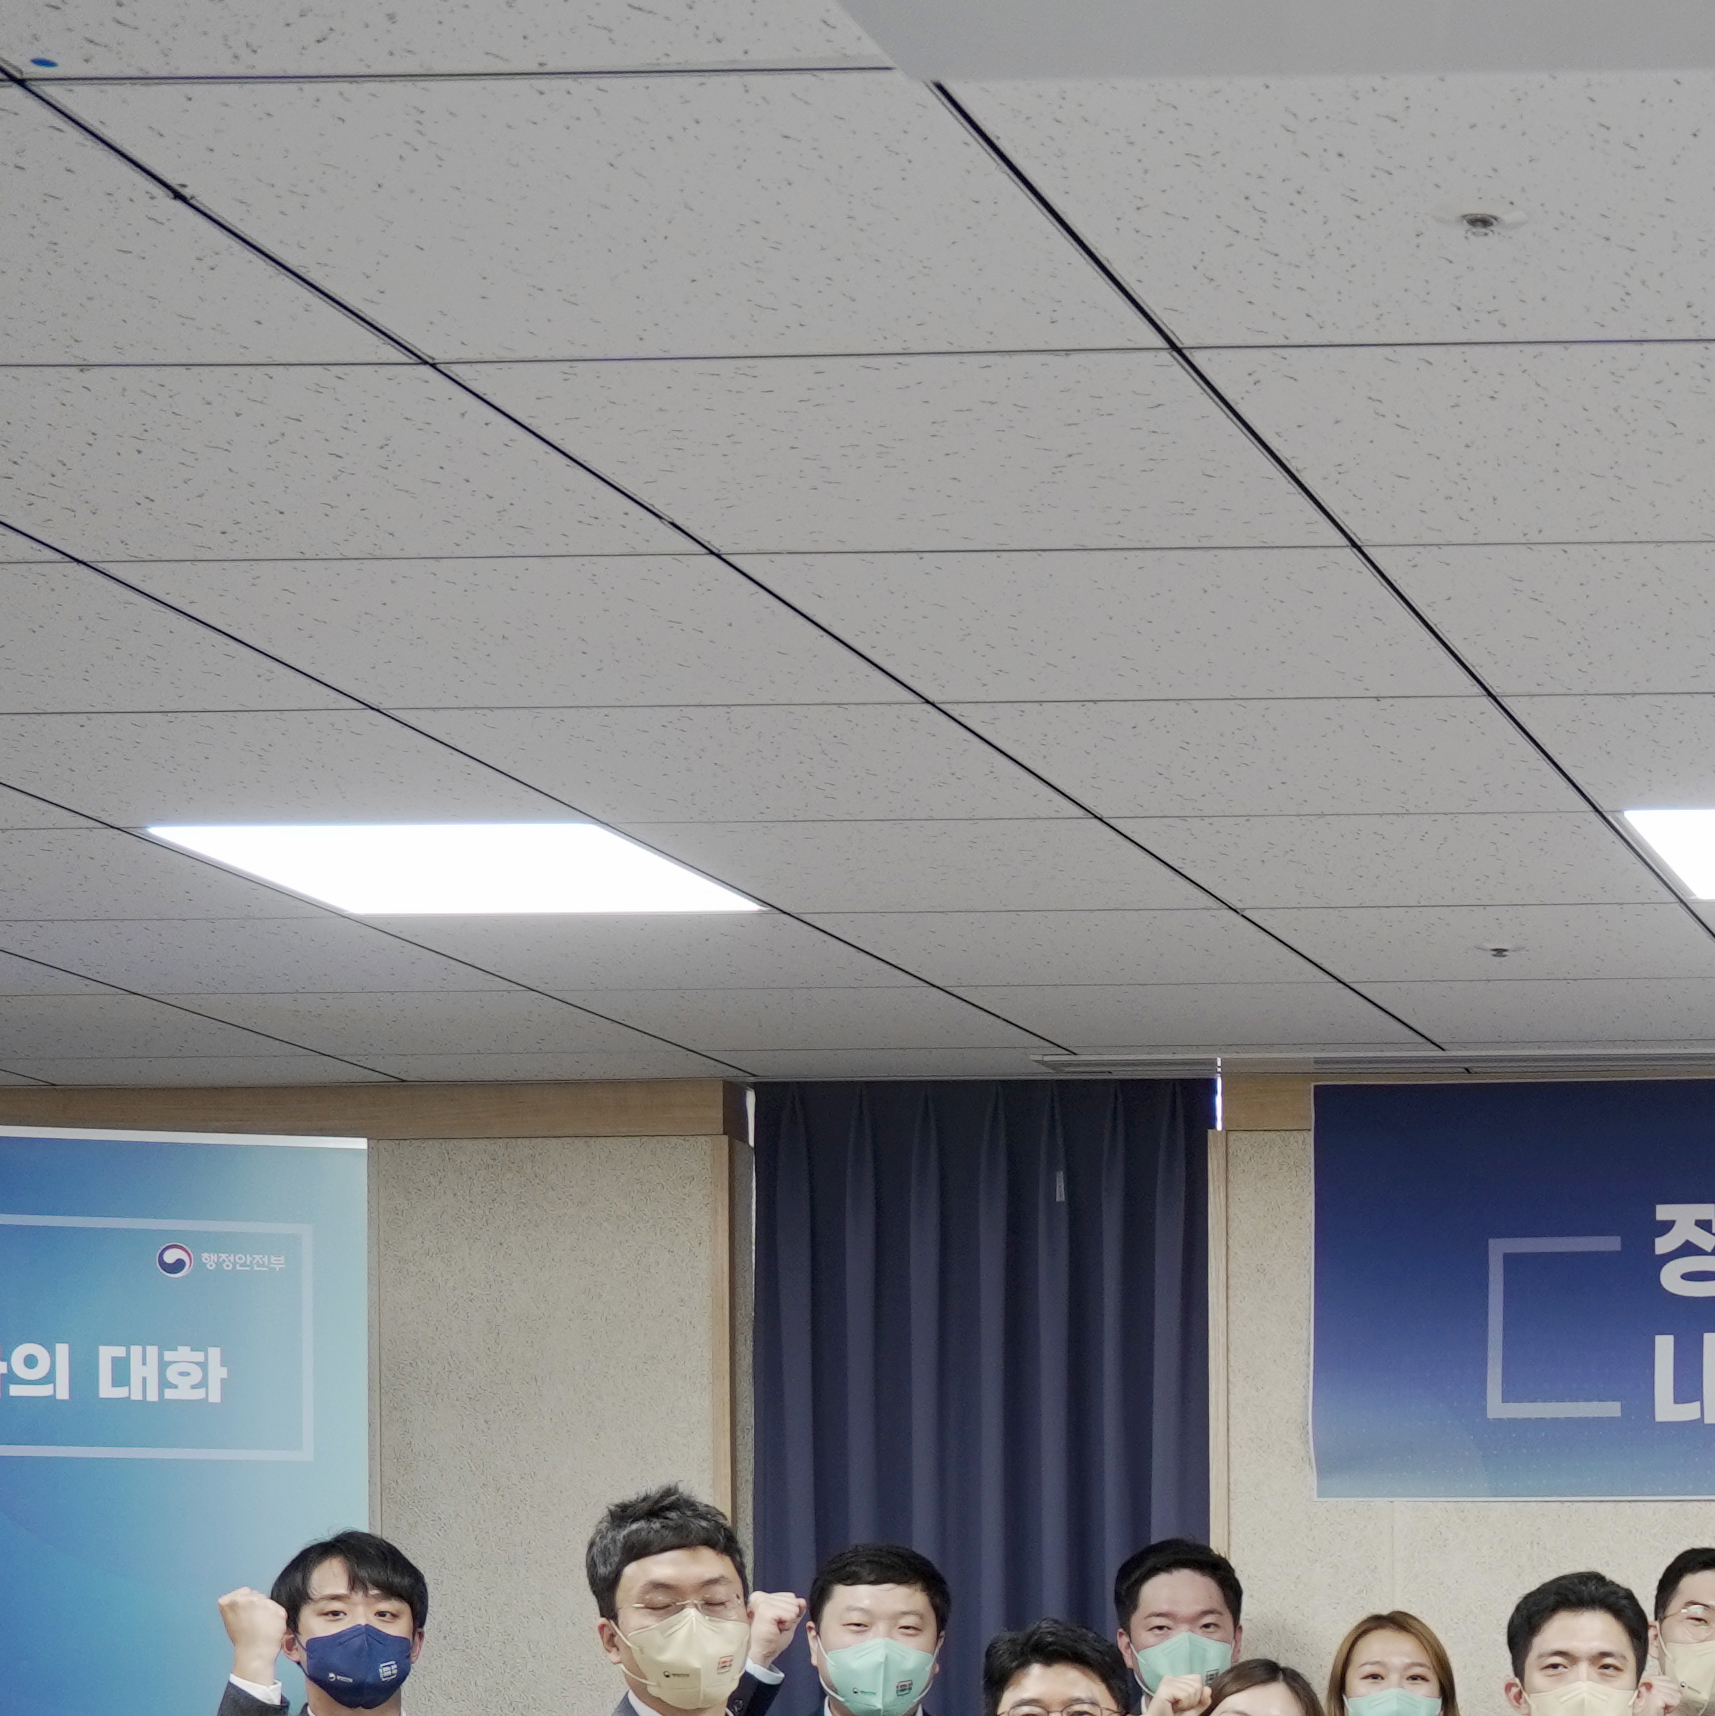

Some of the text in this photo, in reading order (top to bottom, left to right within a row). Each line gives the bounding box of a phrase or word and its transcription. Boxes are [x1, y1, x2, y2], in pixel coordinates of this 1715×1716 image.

[201, 1251, 286, 1272] 행정안전부
[0, 1342, 228, 1403] 의 대화
